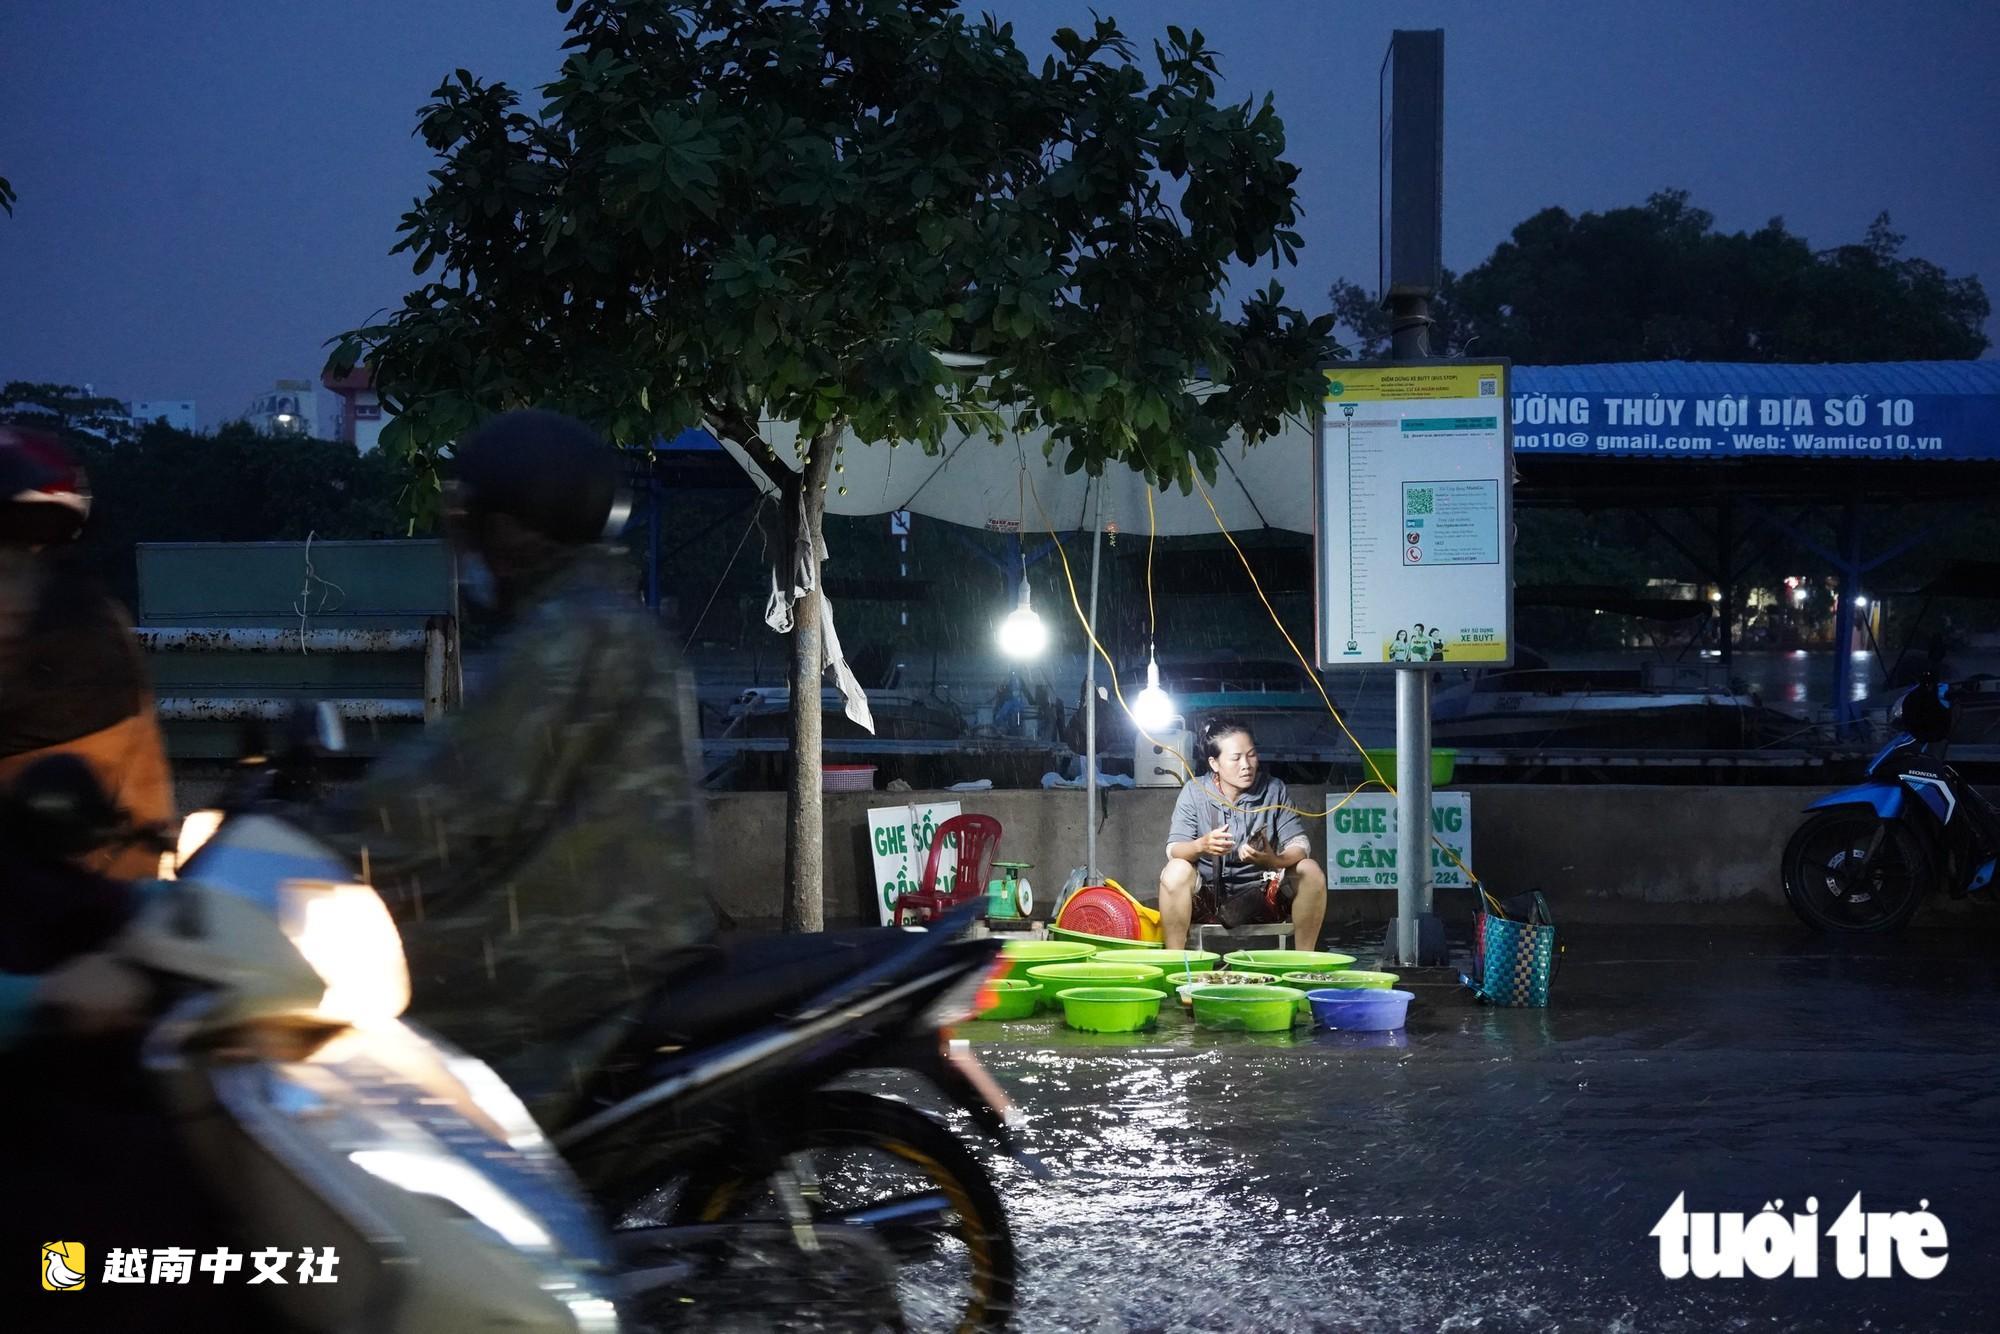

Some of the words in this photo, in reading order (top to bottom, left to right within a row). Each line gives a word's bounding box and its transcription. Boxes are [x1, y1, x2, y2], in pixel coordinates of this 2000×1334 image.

[1604, 393, 1685, 426] THỦY
[1696, 394, 1748, 431] NỘI
[1759, 398, 1814, 431] ĐỊA
[1824, 394, 1869, 426] SỐ
[1877, 399, 1914, 426] 10
[1596, 434, 1712, 450] gmail.com
[1732, 434, 1786, 449] Web:
[1792, 434, 1943, 450] Wamico10.vn
[1461, 634, 1471, 642] XE
[1908, 769, 1938, 778] HONDA
[1334, 807, 1387, 839] GHẸ
[874, 825, 908, 862] GHẸ
[1336, 842, 1398, 868] CẦN
